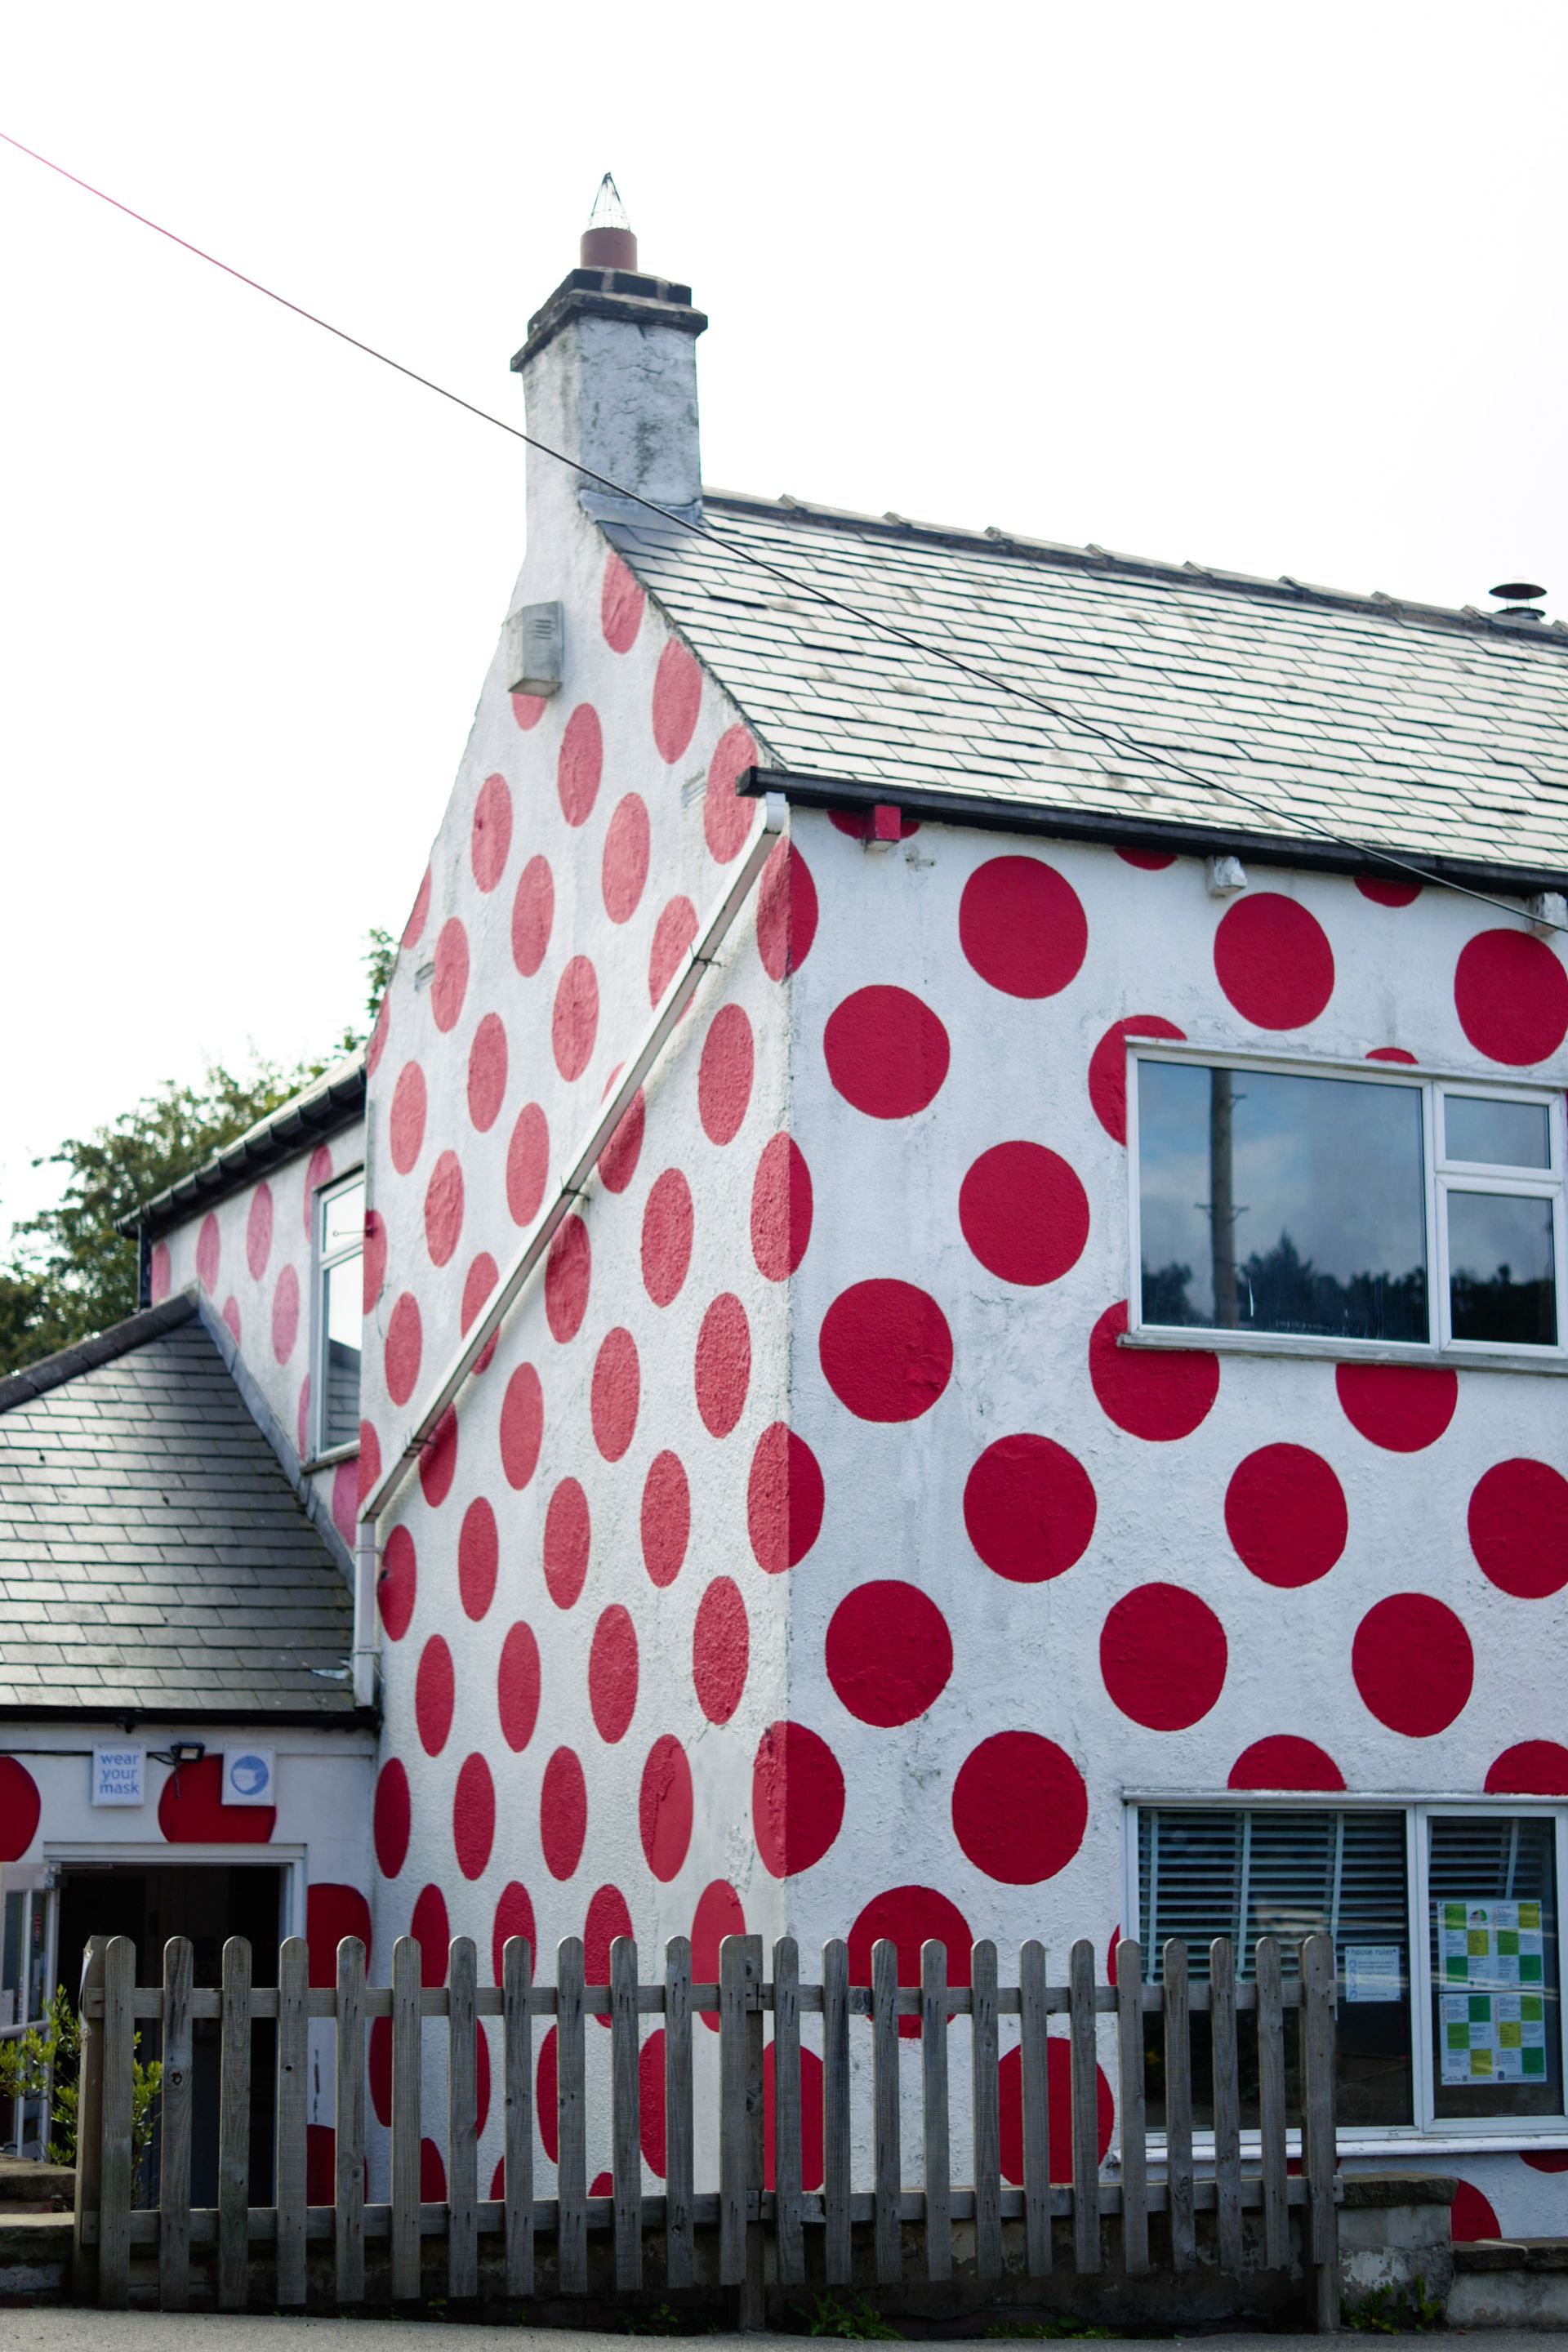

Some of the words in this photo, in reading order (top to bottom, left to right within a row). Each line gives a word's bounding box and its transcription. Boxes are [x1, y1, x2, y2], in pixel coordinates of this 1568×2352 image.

[100, 1754, 140, 1765] wear
[101, 1769, 138, 1782] your
[100, 1781, 140, 1794] mask
